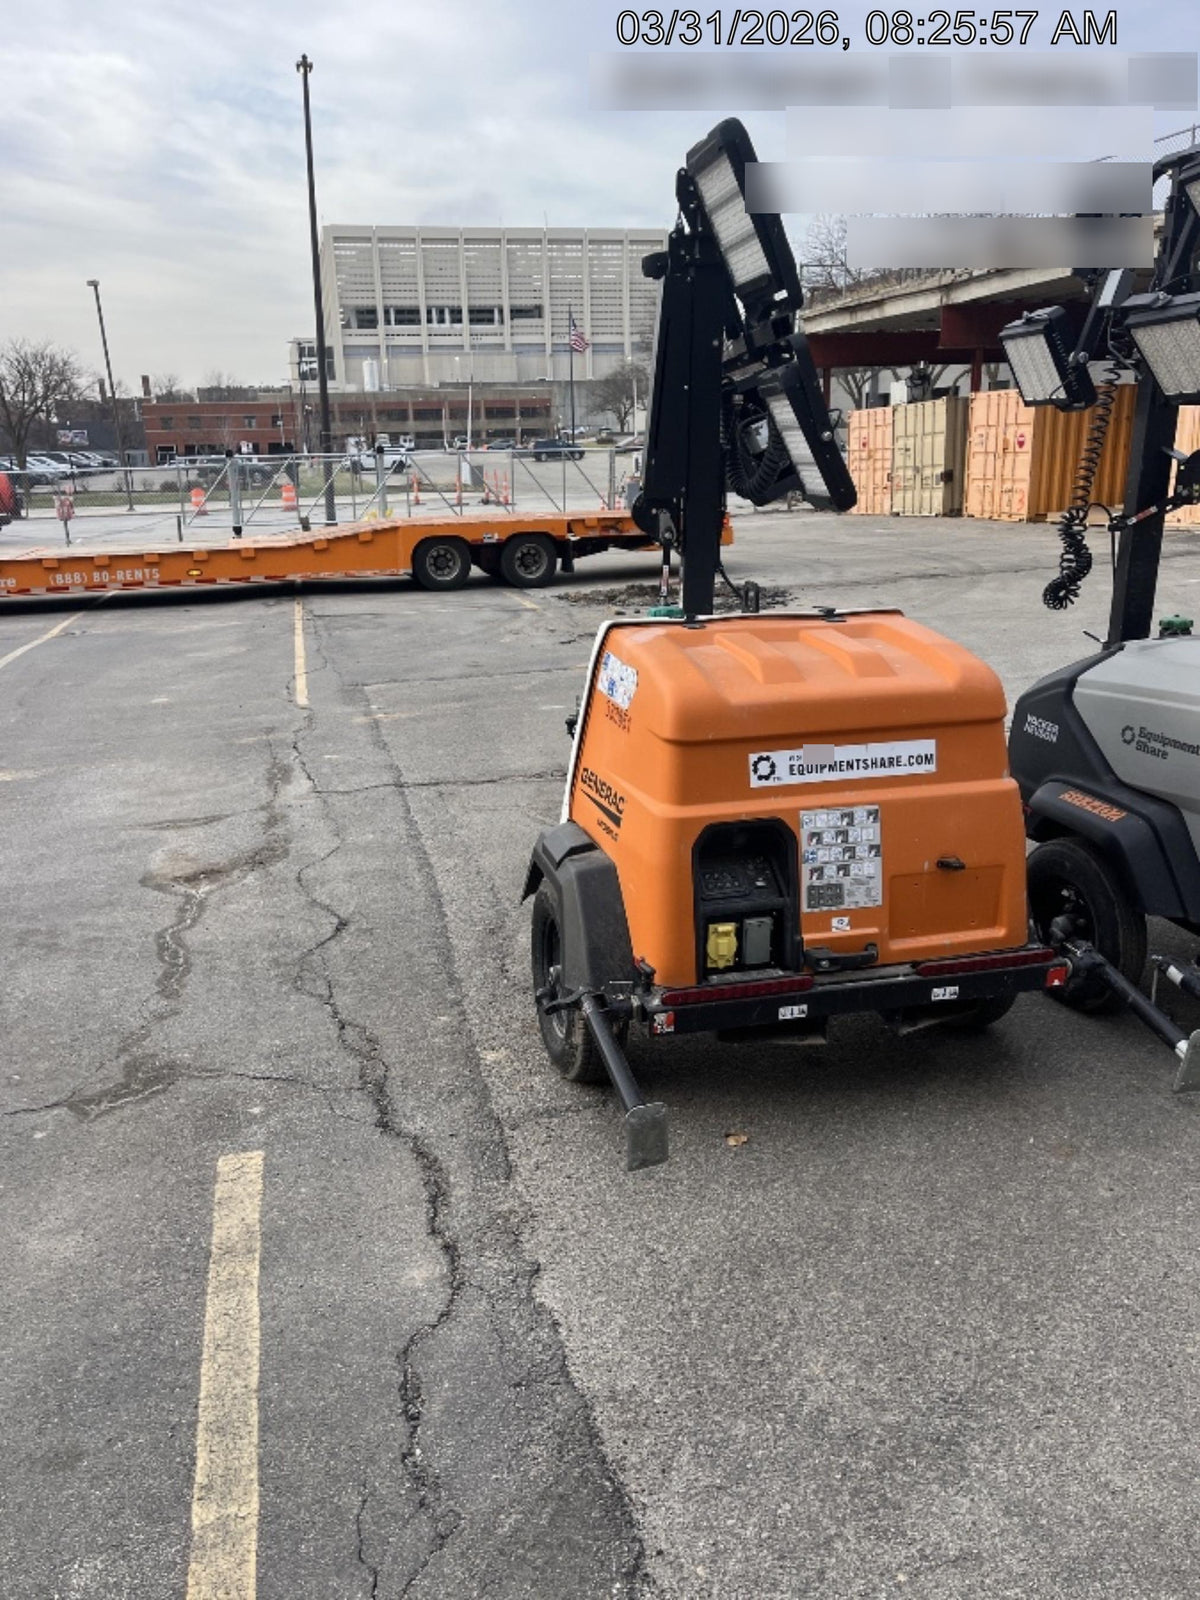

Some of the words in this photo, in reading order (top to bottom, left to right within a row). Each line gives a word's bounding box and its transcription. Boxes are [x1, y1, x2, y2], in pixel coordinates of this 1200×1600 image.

[49, 571, 88, 585] (888)
[1135, 739, 1169, 760] Share
[1138, 726, 1200, 756] Equipment
[788, 753, 935, 776] EQUIPMENTSHARE.COM
[581, 767, 625, 815] GENERAC
